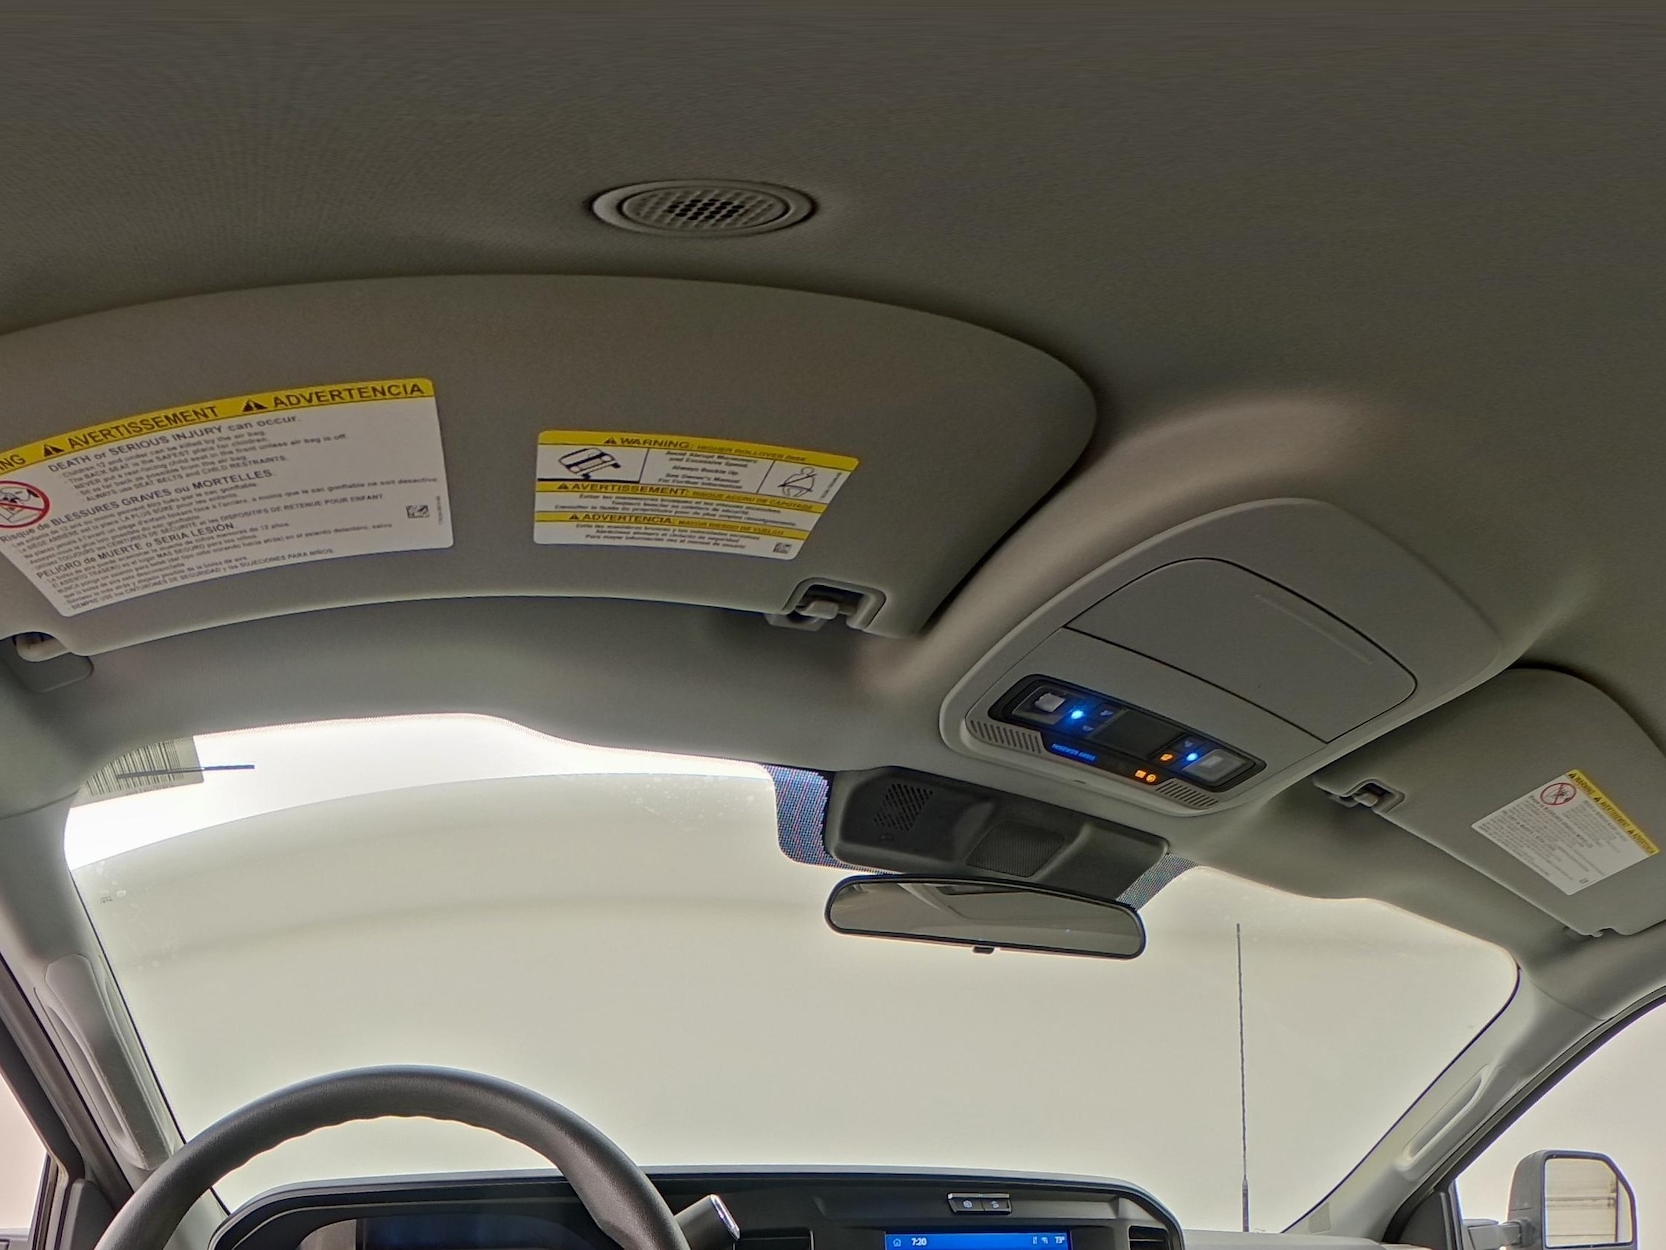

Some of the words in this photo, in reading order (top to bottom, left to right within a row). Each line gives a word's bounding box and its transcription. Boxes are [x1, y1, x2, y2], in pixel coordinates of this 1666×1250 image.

[69, 406, 218, 448] AVERTISSEMENT
[274, 384, 423, 407] ADVERTENCIA
[48, 455, 91, 472] DEATH
[94, 452, 106, 460] or
[109, 436, 169, 455] SERIOUS
[172, 426, 222, 441] INJURY
[228, 422, 253, 431] can
[0, 528, 35, 543] Risque
[37, 523, 50, 531] de
[51, 502, 119, 526] BLESSURES
[121, 489, 171, 506] GRAVES
[174, 486, 190, 494] ou
[36, 560, 82, 578] PELIGRO
[97, 543, 141, 559] MUERTE
[154, 532, 189, 545] SERIA
[911, 1238, 927, 1246] 7:20
